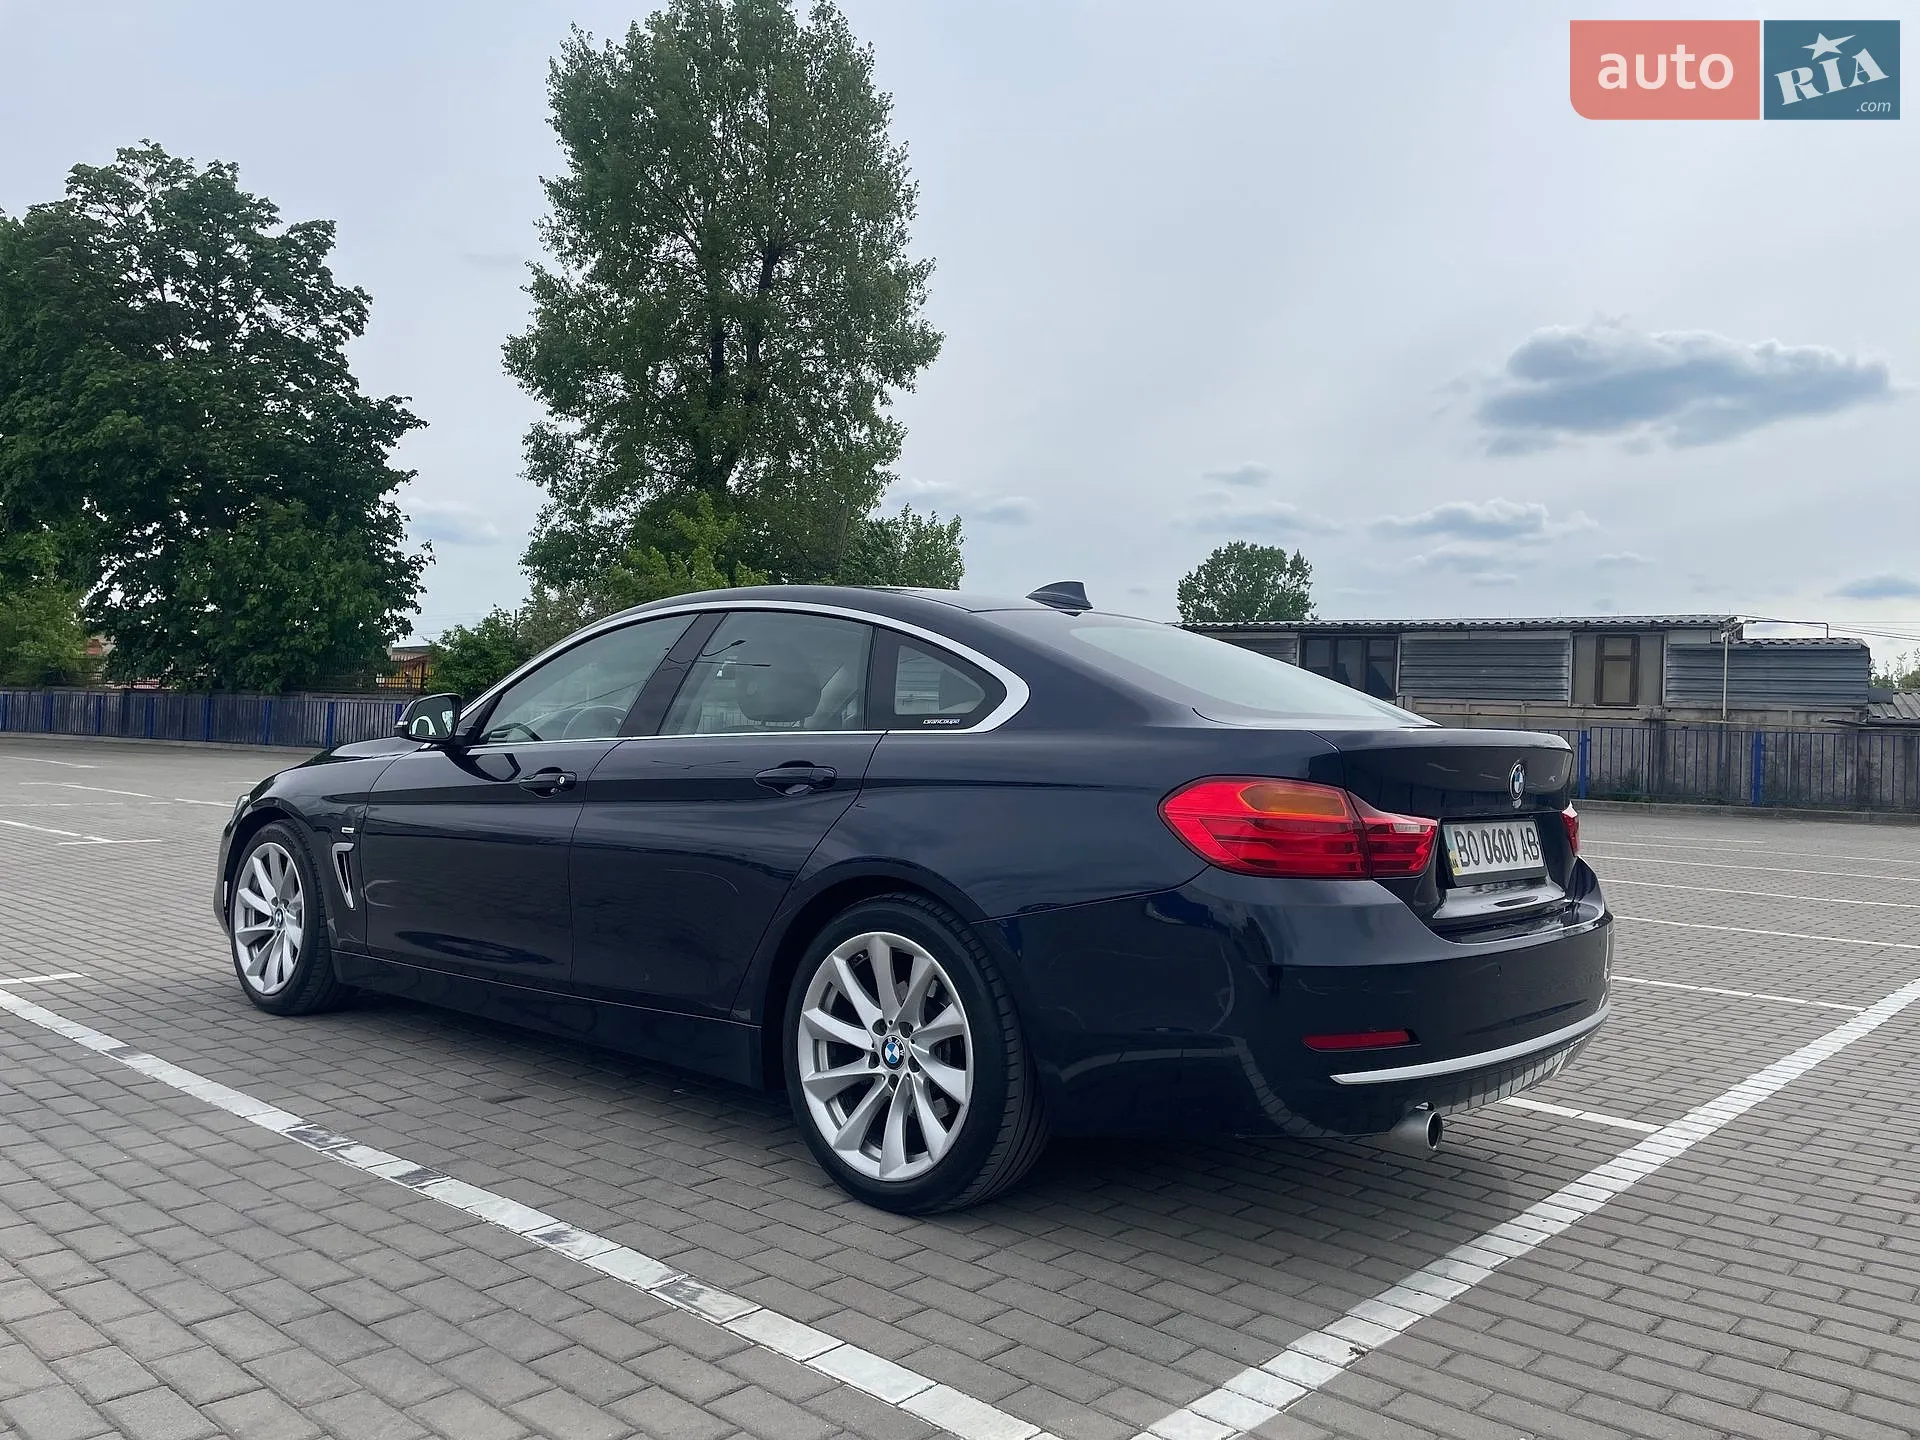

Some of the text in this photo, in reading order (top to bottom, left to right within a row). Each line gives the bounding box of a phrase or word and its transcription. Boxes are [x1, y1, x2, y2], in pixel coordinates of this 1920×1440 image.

[1454, 827, 1540, 867] BO 0600 AB
